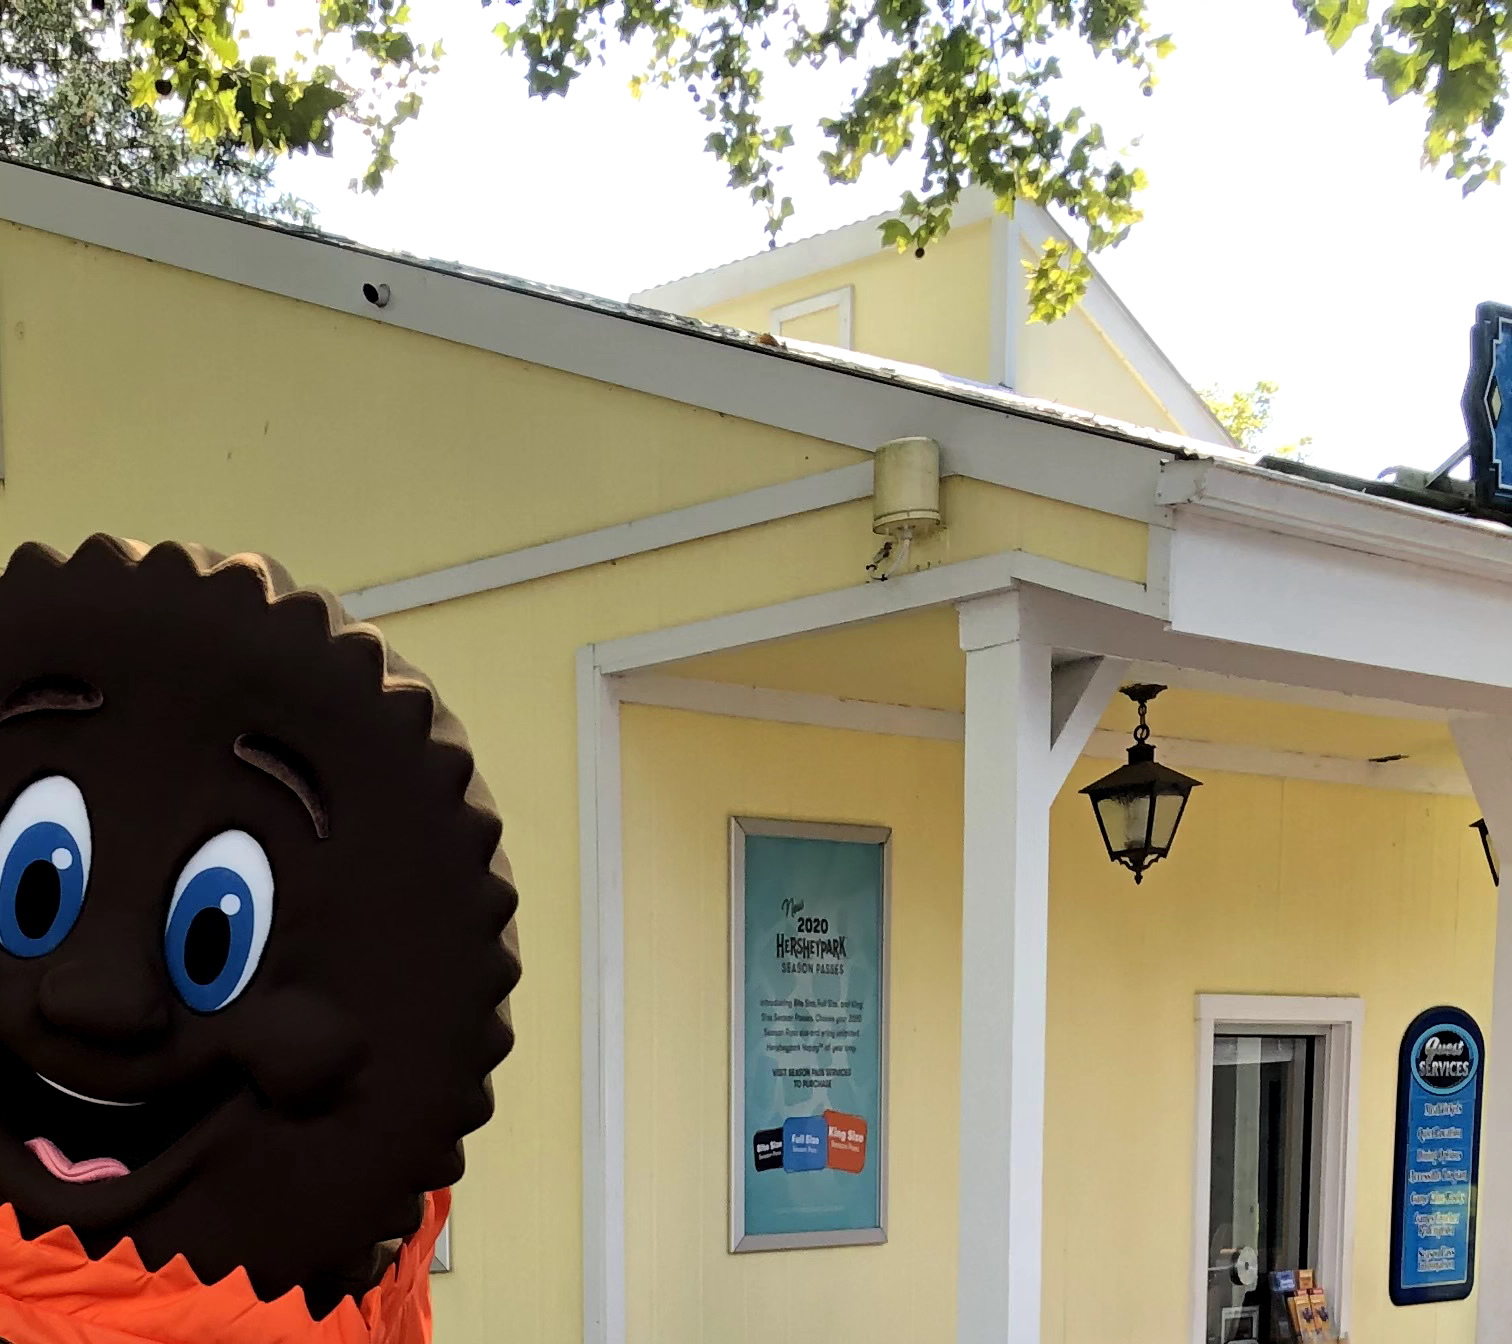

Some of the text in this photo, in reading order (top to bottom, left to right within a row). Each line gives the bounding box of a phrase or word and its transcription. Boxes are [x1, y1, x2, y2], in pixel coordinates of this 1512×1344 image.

[797, 916, 829, 934] 2020
[776, 933, 848, 960] HERSHEYPARK
[781, 962, 845, 975] SEASON PASSES
[1419, 1060, 1470, 1077] SERVICES
[828, 1126, 847, 1142] King
